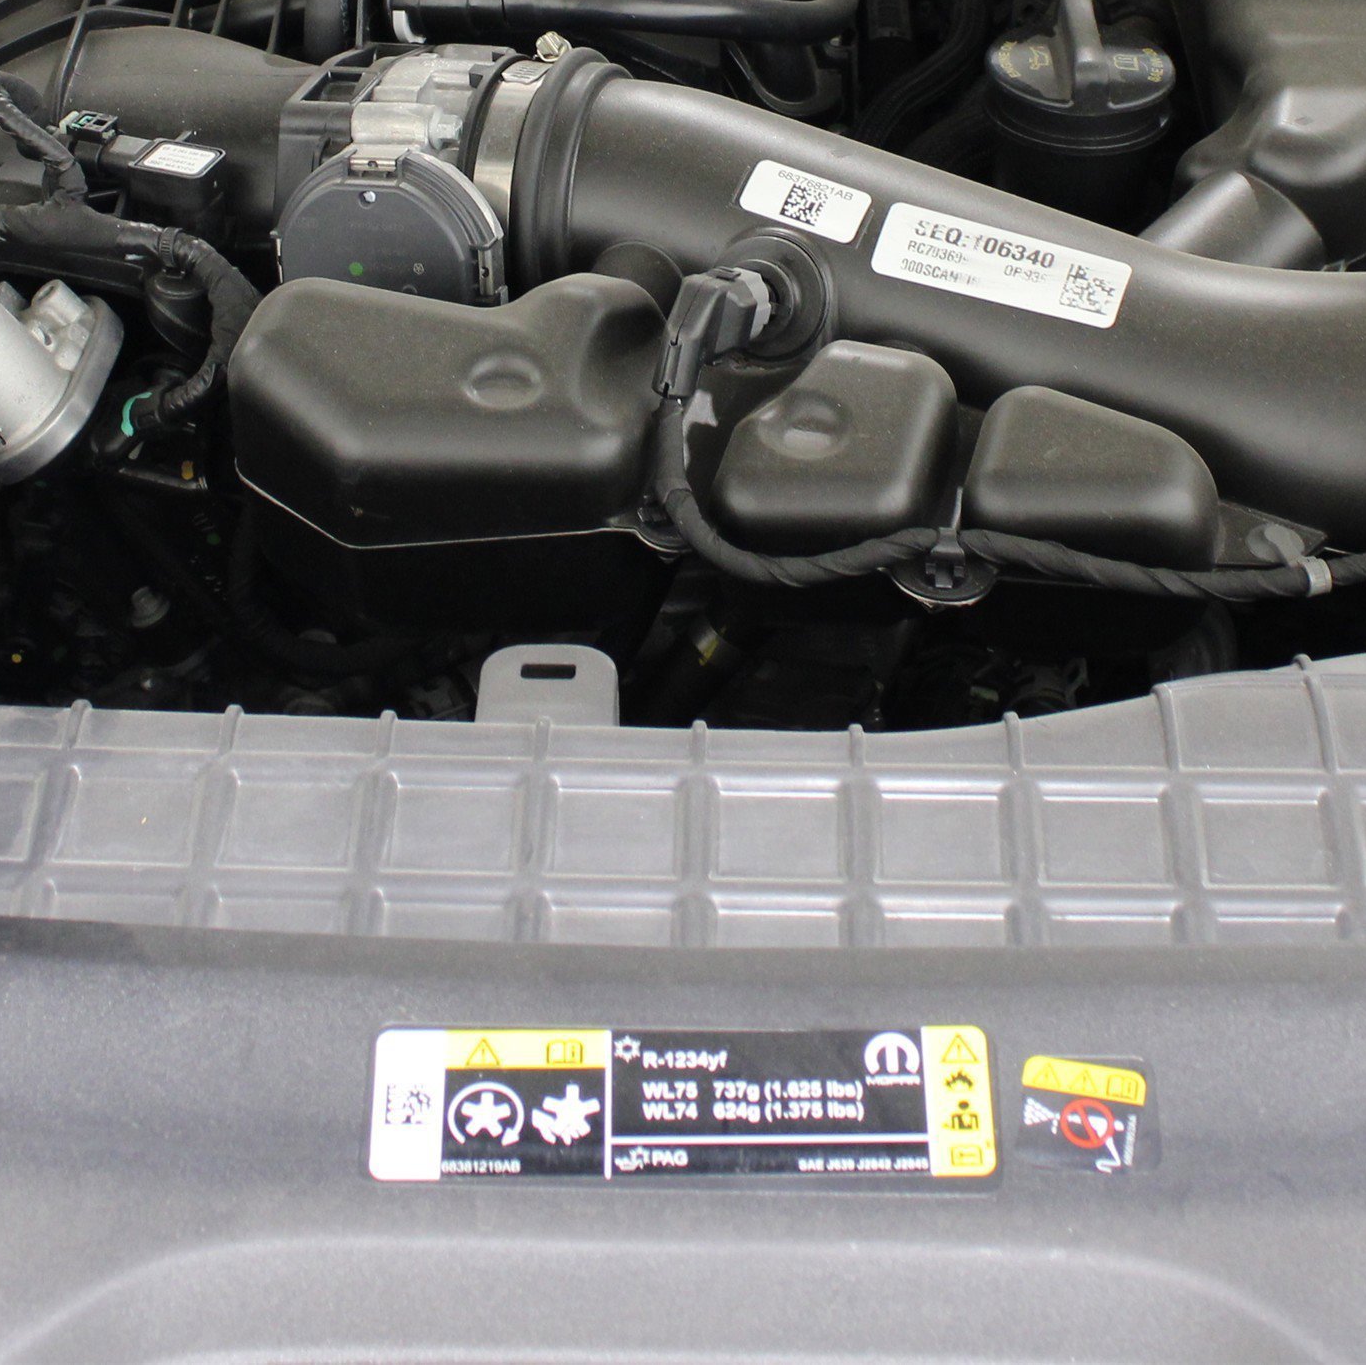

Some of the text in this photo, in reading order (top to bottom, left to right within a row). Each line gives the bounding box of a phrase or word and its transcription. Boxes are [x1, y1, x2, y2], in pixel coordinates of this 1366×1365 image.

[778, 169, 854, 201] 68376821AB
[914, 220, 1055, 269] SEQ:106340
[642, 1049, 728, 1072] R-1234yf
[642, 1080, 863, 1102] WL75 737g (1.625 lbs)
[642, 1101, 864, 1123] WL74 624g (1.375 lbs)
[651, 1150, 688, 1167] PAG
[798, 1158, 824, 1171] SAE
